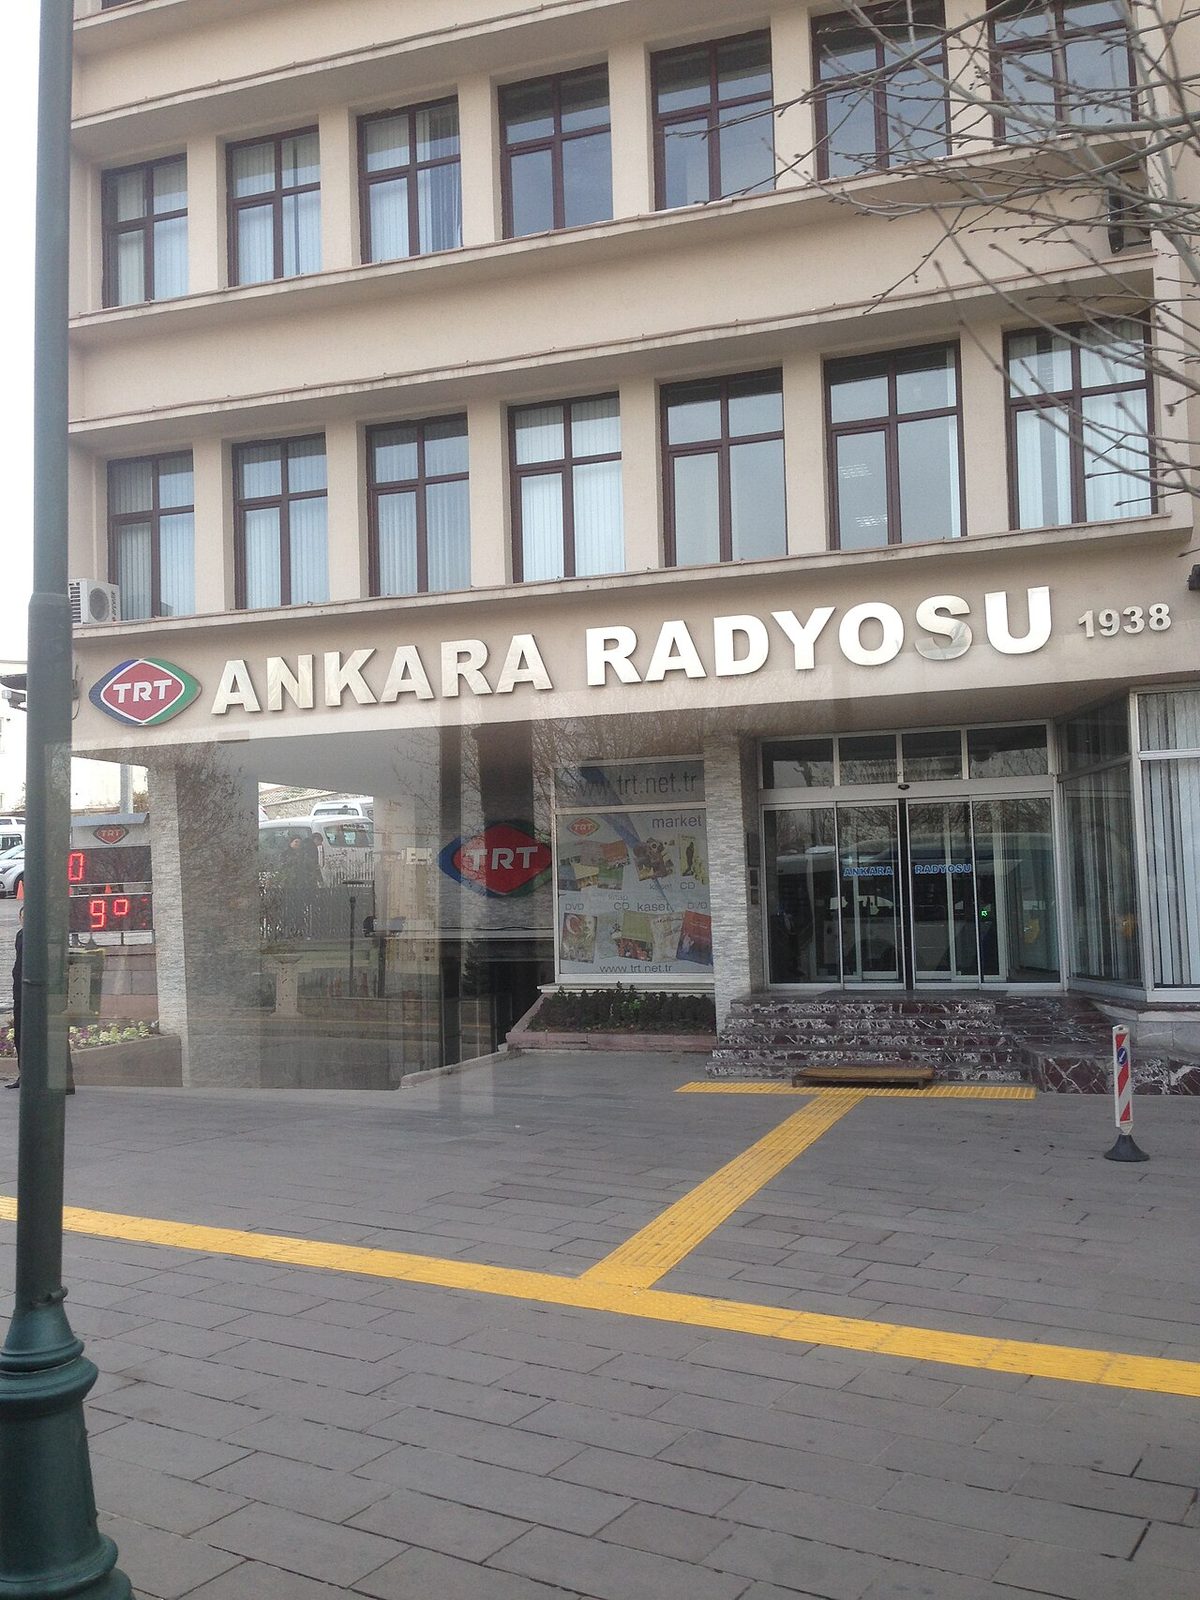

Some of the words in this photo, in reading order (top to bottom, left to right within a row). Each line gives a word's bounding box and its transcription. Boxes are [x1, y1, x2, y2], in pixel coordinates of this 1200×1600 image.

[211, 634, 554, 715] ANKARA
[586, 586, 1052, 686] RADYOSU
[1077, 603, 1173, 638] 1938
[112, 679, 172, 704] TRT
[652, 815, 703, 829] market
[100, 829, 120, 837] TRT
[466, 846, 538, 871] TRT
[843, 865, 894, 877] ANKARA
[914, 863, 972, 875] RADYOSU
[680, 881, 696, 890] CD
[565, 903, 584, 911] DVD
[637, 902, 671, 912] kaset
